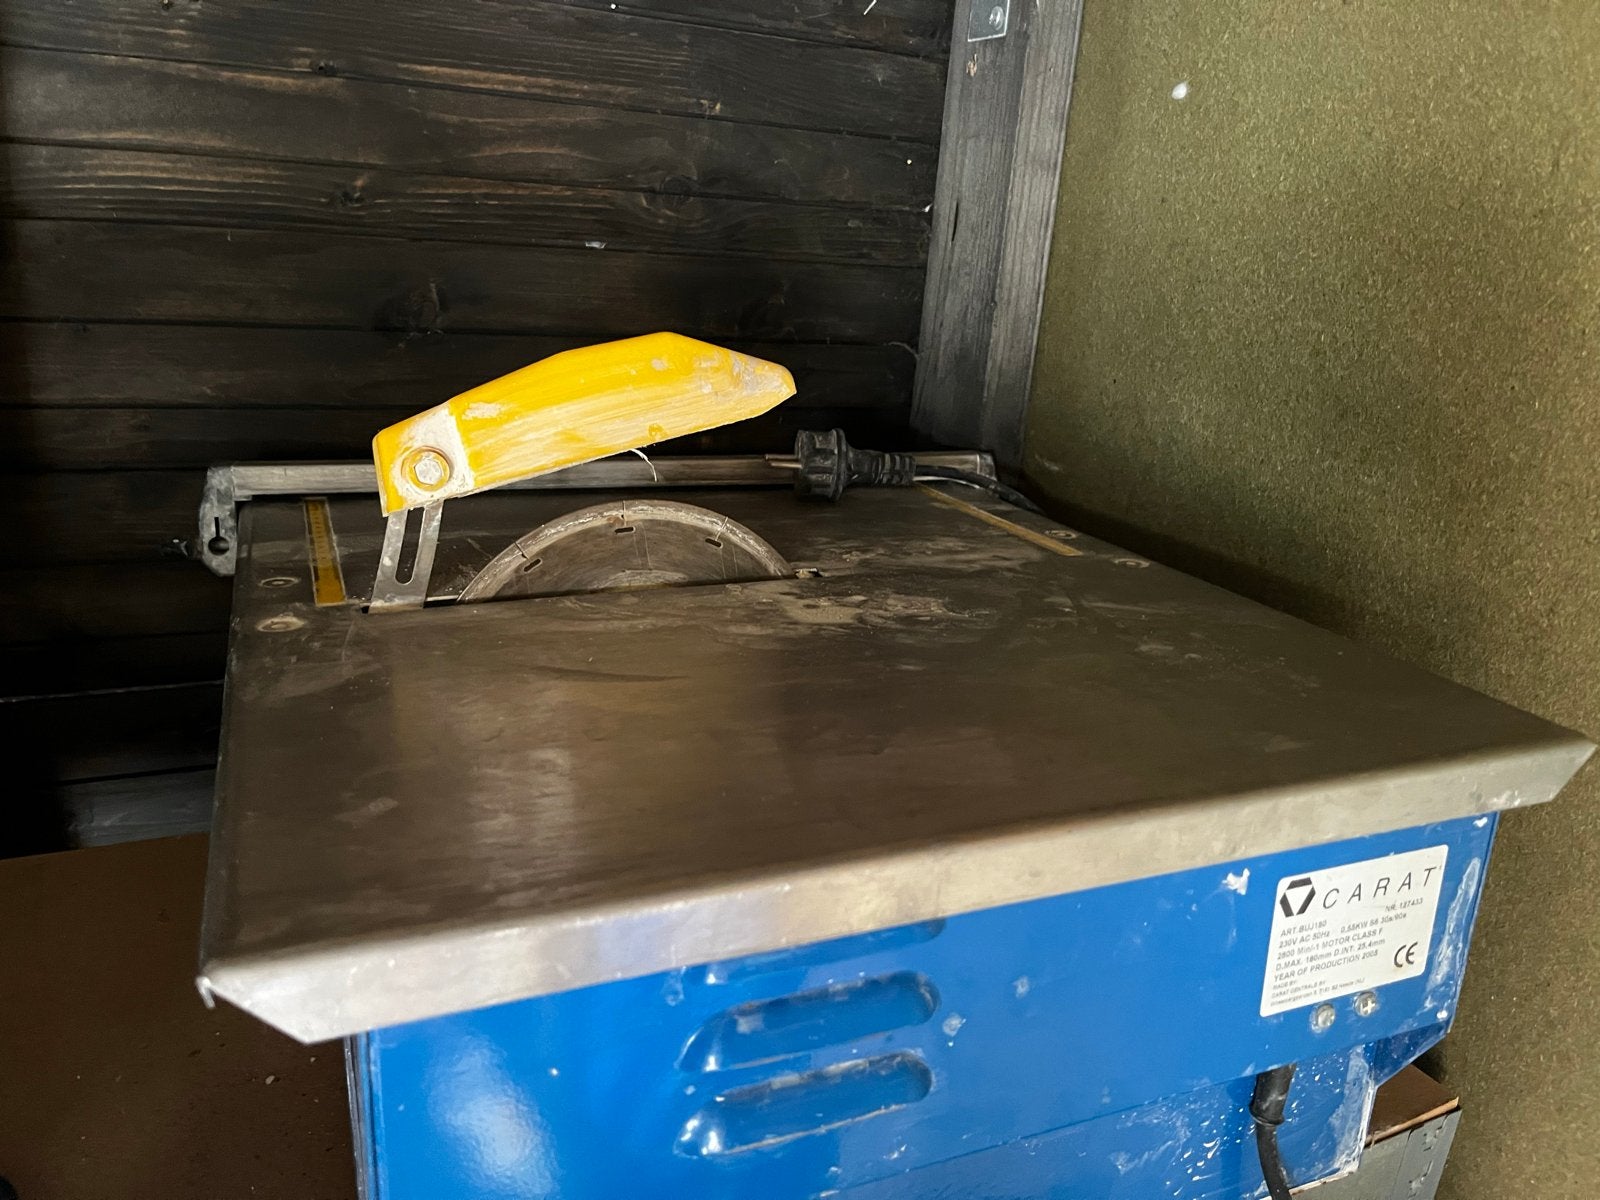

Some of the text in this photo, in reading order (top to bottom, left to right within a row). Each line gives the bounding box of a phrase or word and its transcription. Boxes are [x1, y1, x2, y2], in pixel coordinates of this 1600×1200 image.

[1323, 867, 1437, 909] CARAT
[1278, 938, 1297, 948] 230V
[1299, 934, 1310, 943] AC
[1311, 930, 1330, 940] 50Hz
[1321, 935, 1349, 948] MOTOR
[1351, 929, 1376, 940] CLASS
[1273, 970, 1295, 982] YEAR
[1297, 967, 1307, 976] OF
[1310, 953, 1360, 972] PRODUCTION
